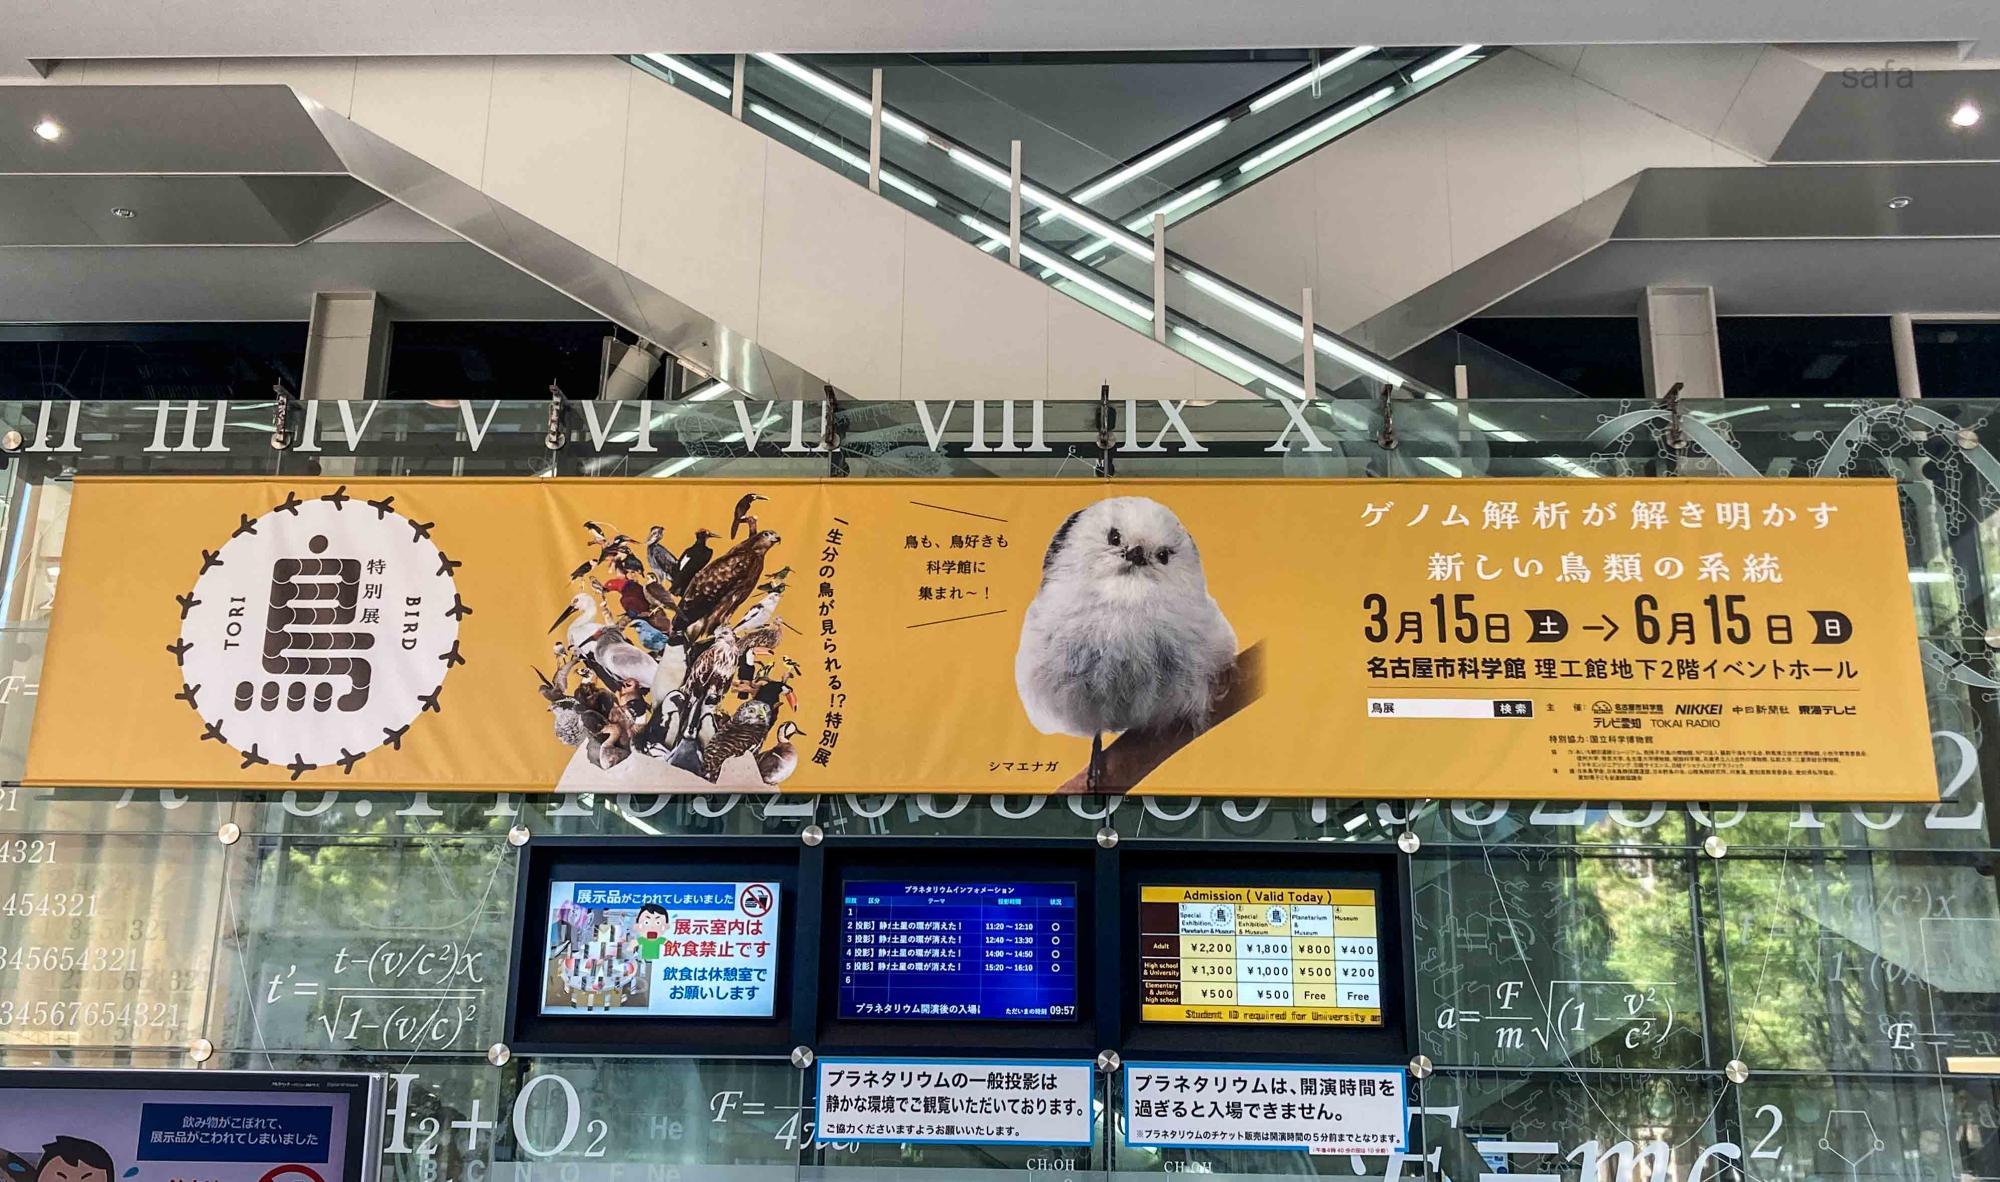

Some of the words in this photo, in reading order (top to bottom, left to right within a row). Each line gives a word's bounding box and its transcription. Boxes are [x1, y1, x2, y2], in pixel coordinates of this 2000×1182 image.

[1360, 500, 1838, 530] ゲノム解析が解き明かす
[904, 534, 1009, 550] 鳥も、鳥好きも
[926, 560, 986, 575] 科学館に
[1427, 552, 1783, 583] 新しい鳥類の系統
[360, 558, 387, 624] 特別展
[224, 596, 246, 650] TORI
[401, 596, 422, 650] BIRD
[1363, 593, 1510, 644] 3月15日
[1366, 656, 1526, 680] 名古屋市科学館
[1371, 702, 1395, 714] 鳥展
[1499, 702, 1527, 715] 検索
[1674, 704, 1723, 715] NIKKEI
[1650, 718, 1683, 728] TOKAI
[1686, 718, 1720, 728] RADIO
[988, 760, 1060, 773] シマエナガ
[0, 840, 56, 863] 4321
[577, 889, 733, 904] 展示品がこわれてしまいました
[905, 886, 1015, 894] プラネタリウムインフォメーション
[1183, 890, 1242, 901] Admission
[2, 893, 98, 917] 454321
[673, 918, 763, 936] 展示室内は
[663, 940, 770, 958] 飲食禁止です
[663, 966, 767, 982] 飲食は休憩室で
[669, 985, 759, 1000] お願いします
[1145, 996, 1159, 1004] high
[1304, 991, 1326, 1000] Free
[1347, 992, 1369, 1001] Free
[1050, 1005, 1074, 1015] 09:57
[1185, 1009, 1223, 1019] Student
[1228, 1011, 1239, 1019] ID
[1244, 1011, 1287, 1021] required
[1291, 1012, 1306, 1020] for
[1312, 1011, 1365, 1022] University
[828, 1070, 1058, 1091] プラネタリウムの一般投影は
[1135, 1075, 1395, 1097] プラネタリウムは、開演時間を
[826, 1094, 1084, 1117] 静かな環境でご観覧いただいております。
[1134, 1100, 1343, 1122] 過ぎると入場できません。
[182, 1115, 283, 1129] 飲み物がこぼれて、
[649, 1116, 683, 1140] He
[826, 1123, 1020, 1137] ご協力くださいますようお願いいたします。
[150, 1130, 319, 1146] 展示品がこわれてしまいました
